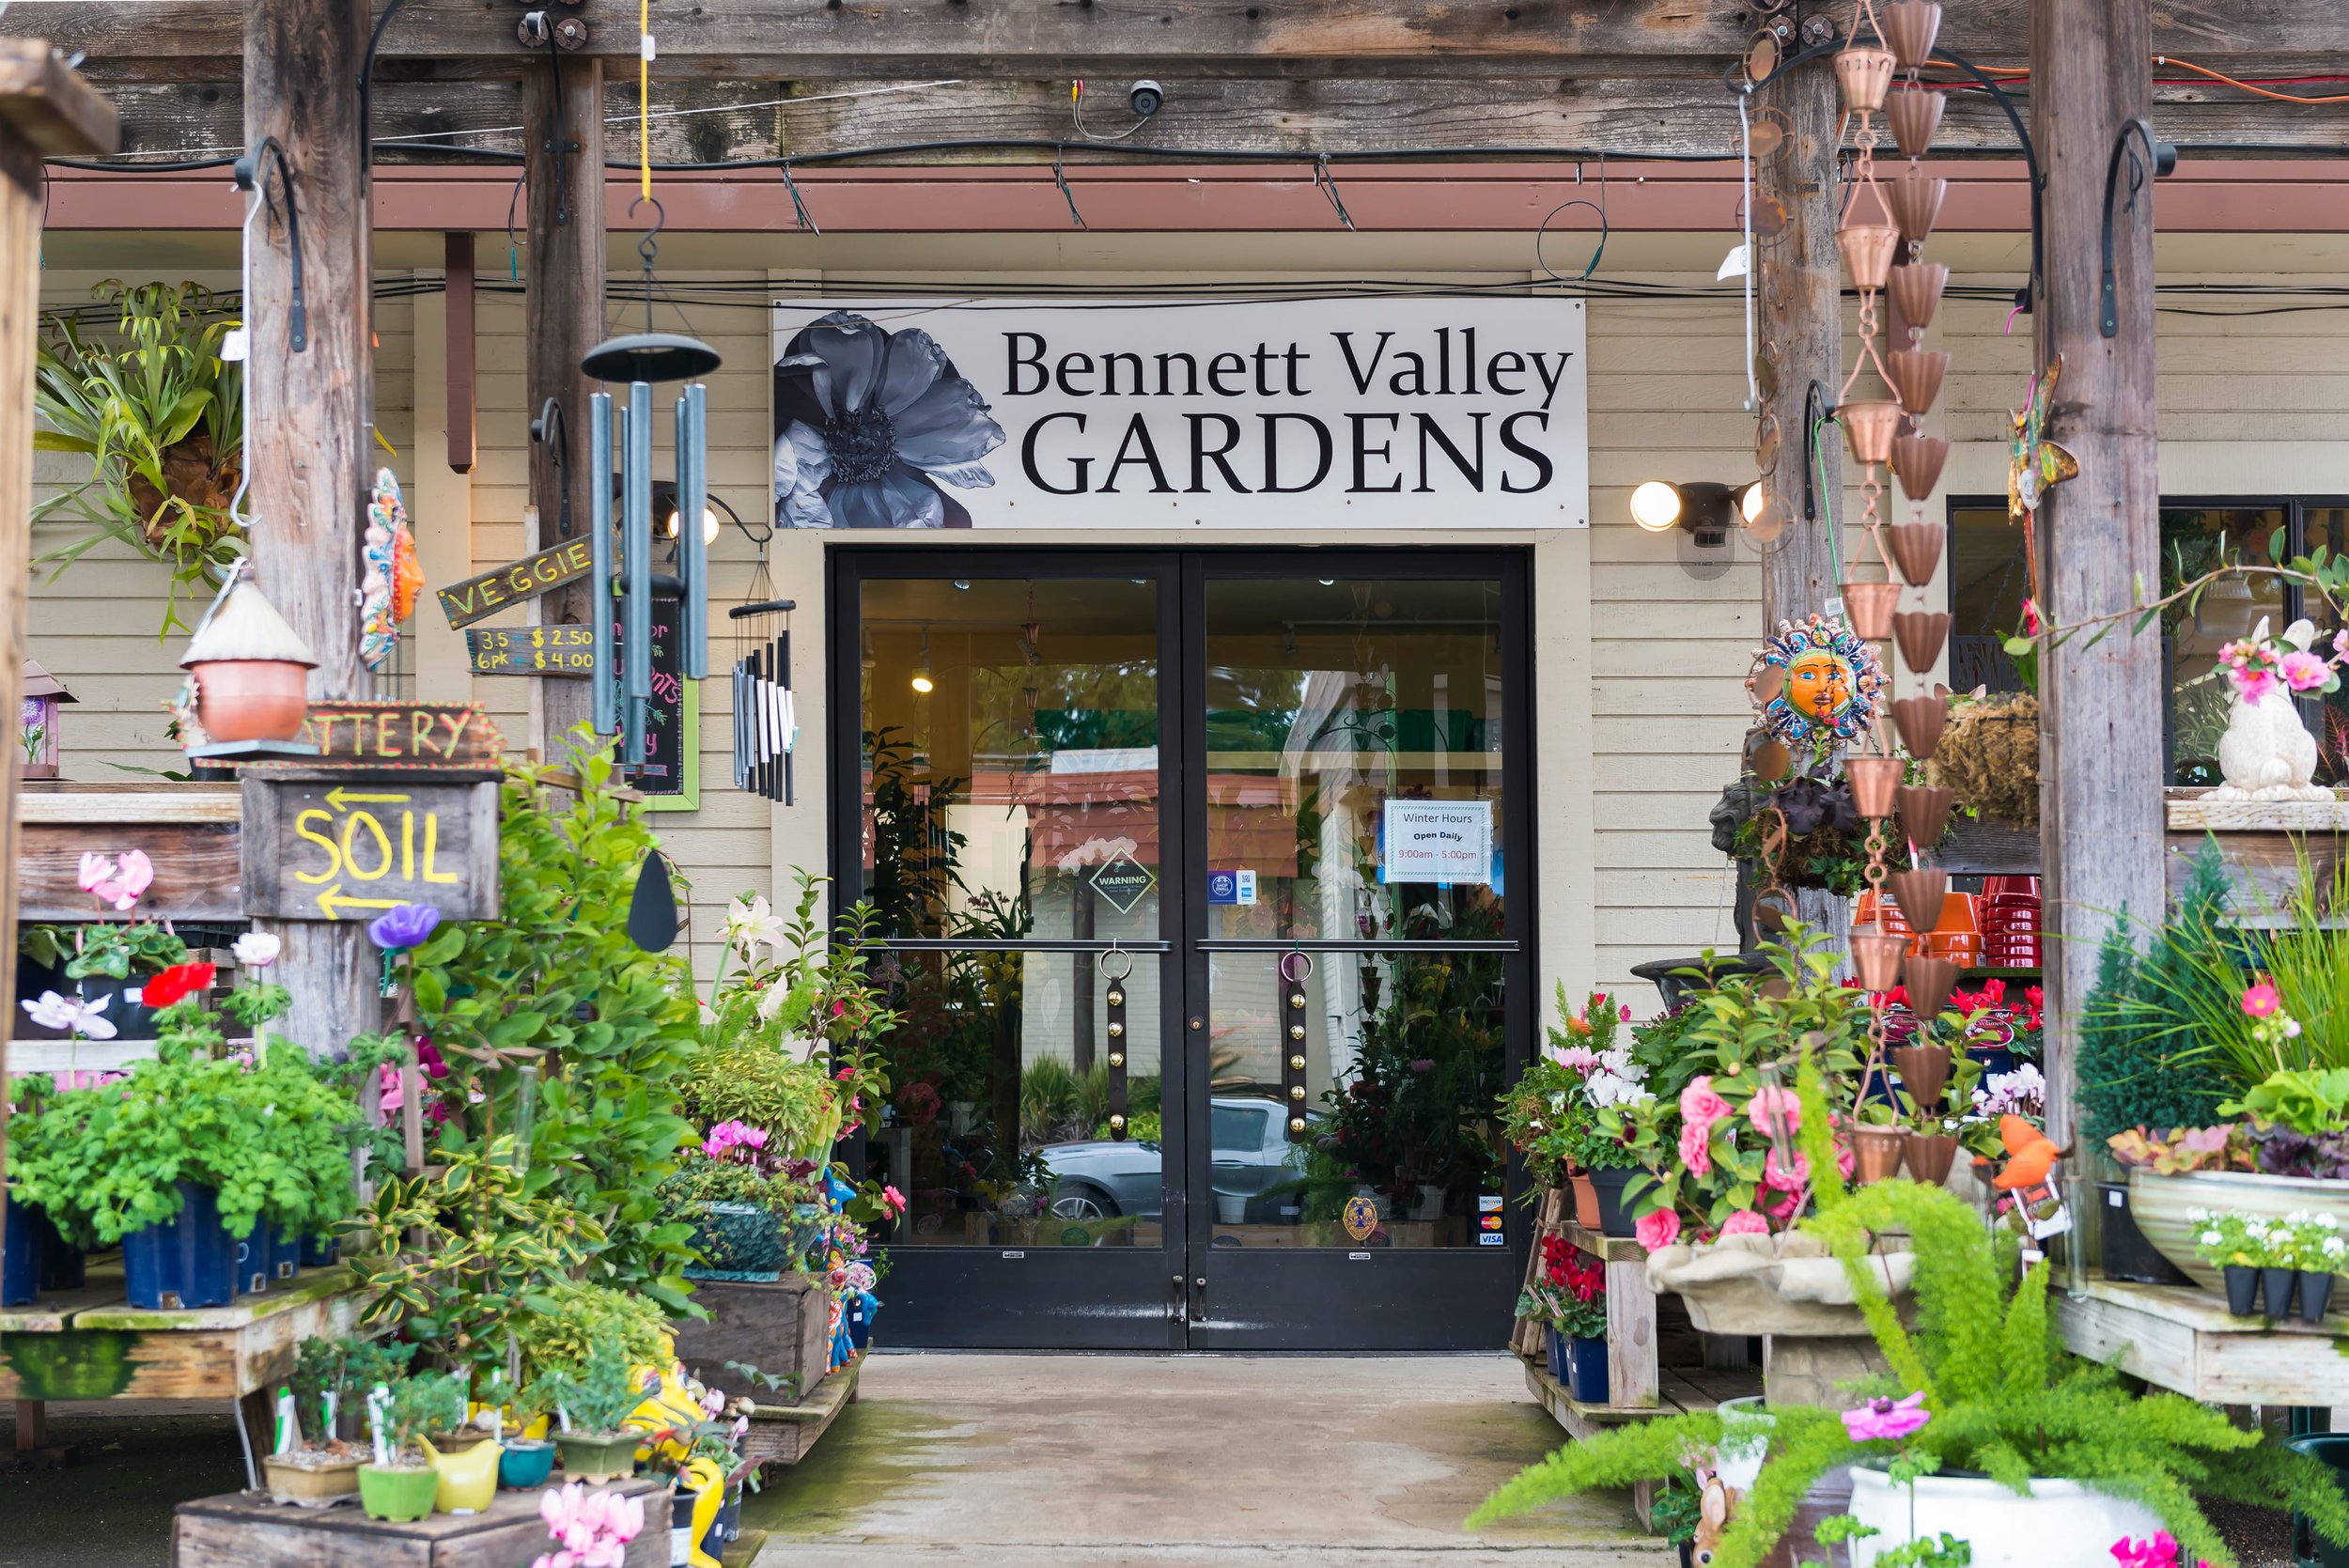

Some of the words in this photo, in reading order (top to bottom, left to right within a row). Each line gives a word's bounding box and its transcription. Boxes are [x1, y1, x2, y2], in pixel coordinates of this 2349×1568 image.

[1002, 331, 1312, 397] Bennett
[1330, 326, 1574, 411] Valley
[1020, 411, 1554, 495] GARDENS
[447, 542, 592, 614] VEGGIE
[480, 631, 509, 650] 3.5
[476, 651, 509, 669] 6pk
[303, 709, 472, 758] TTERY
[1403, 813, 1439, 824] Winter
[1441, 814, 1472, 824] Hours
[1413, 832, 1438, 841] Open
[1439, 831, 1463, 842] Daily
[294, 808, 459, 885] SOIL
[1398, 849, 1433, 859] 9:00am
[1441, 850, 1477, 861] 5:00pm
[1098, 876, 1147, 886] WARNING
